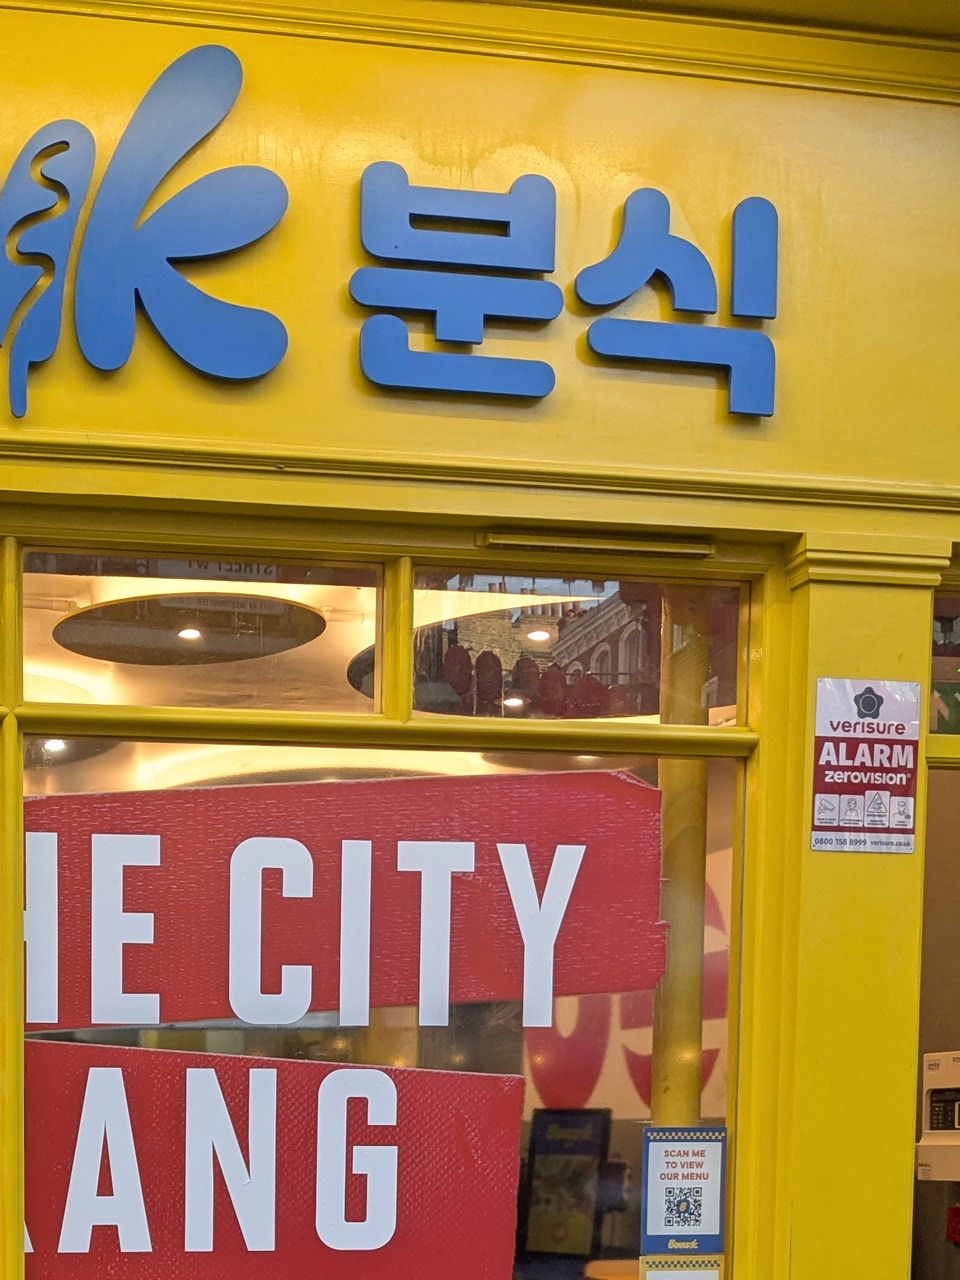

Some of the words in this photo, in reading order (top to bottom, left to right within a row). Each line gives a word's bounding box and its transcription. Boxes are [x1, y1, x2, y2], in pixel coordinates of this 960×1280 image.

[349, 161, 778, 417] 분식
[829, 720, 906, 735] verisure
[818, 741, 914, 769] ALARM
[814, 838, 833, 846] 0800
[835, 838, 848, 846] 158
[849, 838, 867, 847] 8999
[228, 836, 586, 1028] CITY
[664, 1150, 689, 1158] SCAN
[692, 1150, 706, 1158] ME
[665, 1161, 677, 1169] TO
[680, 1161, 704, 1169] VIEW
[659, 1173, 679, 1181] OUR
